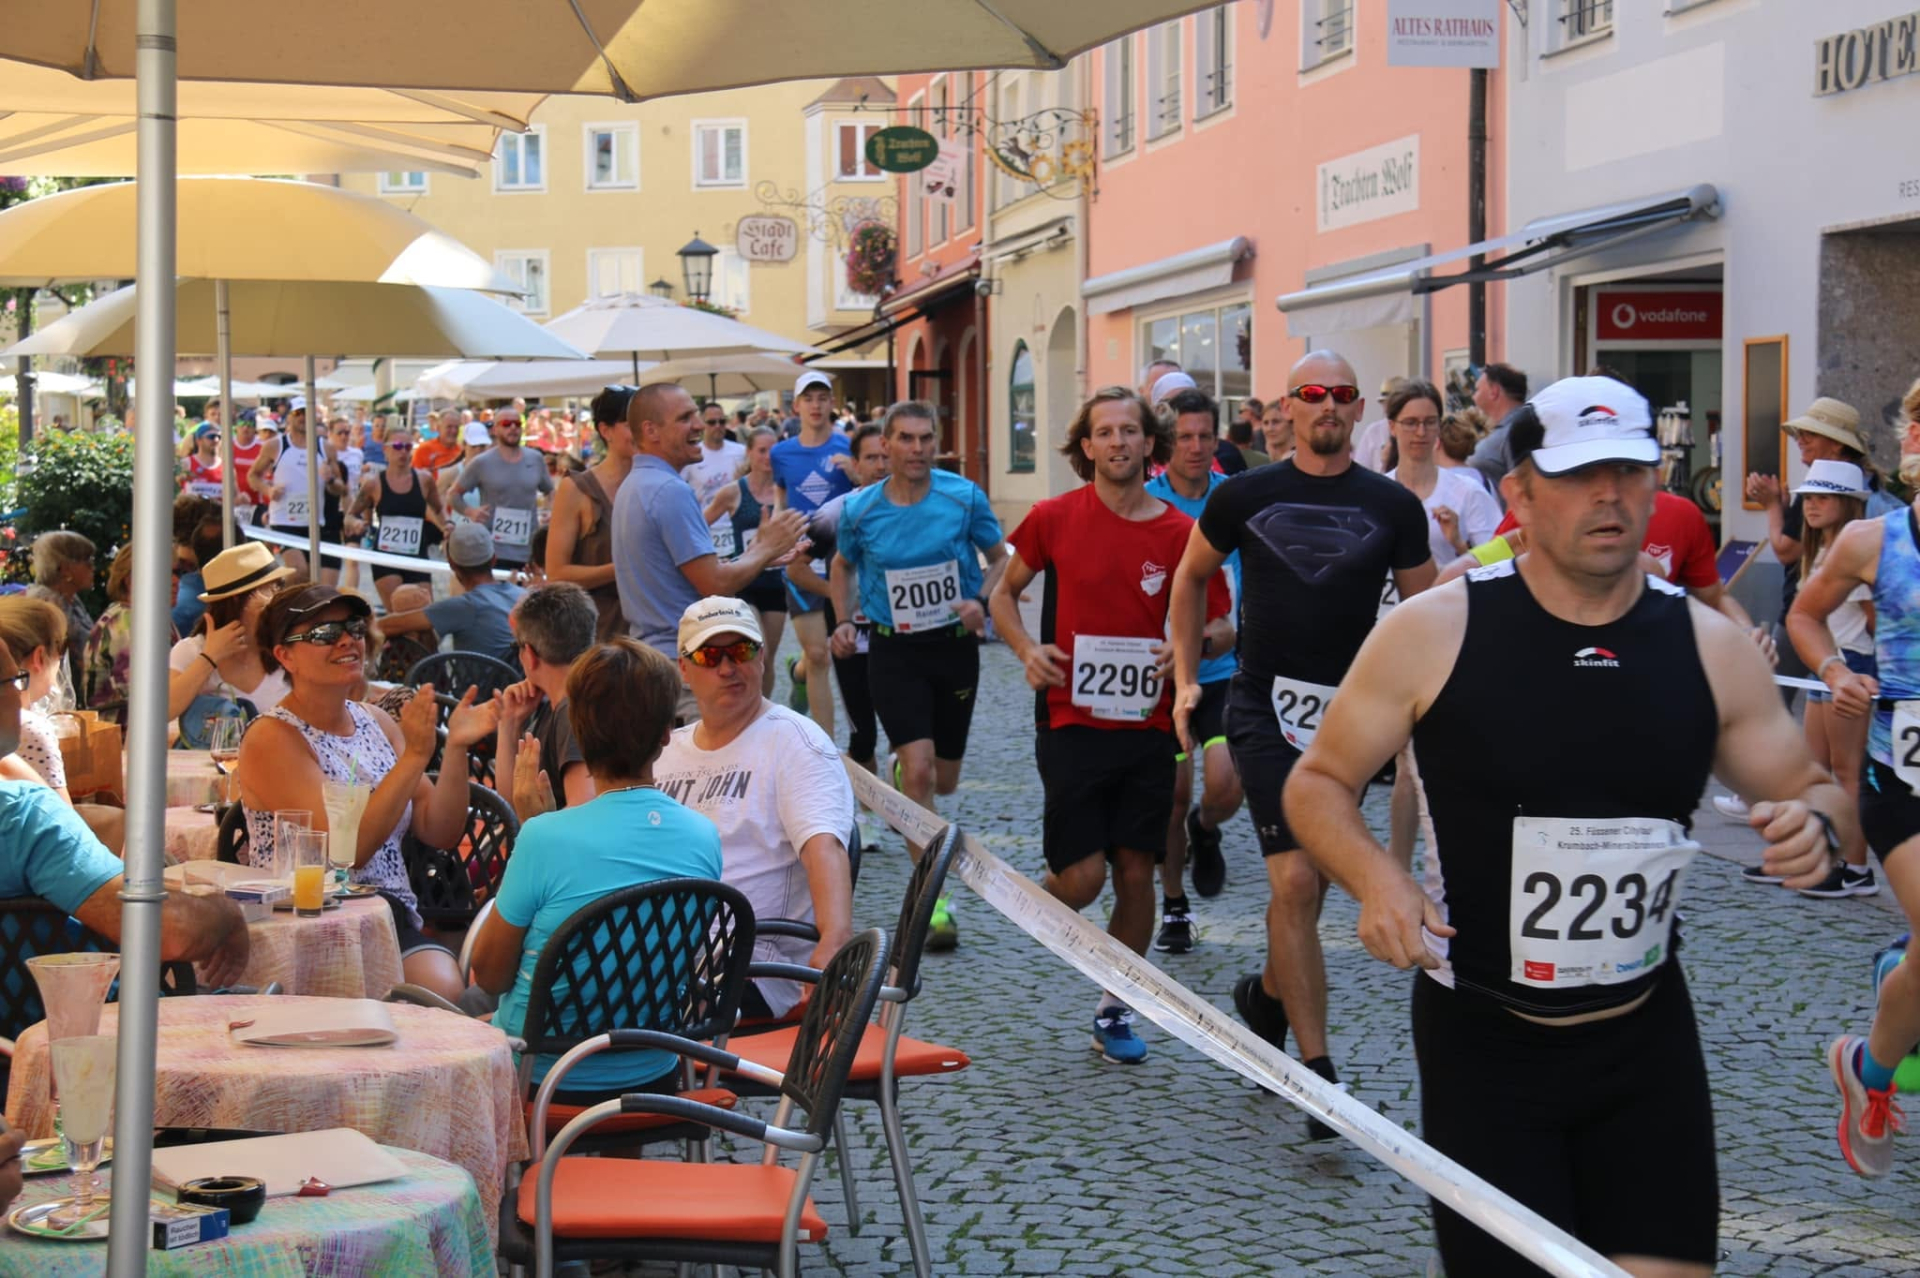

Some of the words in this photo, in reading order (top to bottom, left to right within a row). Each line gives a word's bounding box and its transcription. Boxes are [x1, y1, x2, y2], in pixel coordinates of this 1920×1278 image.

[1393, 17, 1431, 36] ALTES
[1434, 18, 1494, 37] RATHAUS
[1813, 10, 1920, 98] HOTE
[1639, 307, 1708, 322] vodafone
[1578, 415, 1619, 427] skinfit
[382, 526, 419, 544] 2210
[494, 518, 528, 535] 2211
[892, 575, 956, 610] 2008
[1574, 656, 1620, 667] skinfit
[1077, 662, 1159, 698] 2296
[1278, 689, 1331, 730] 22
[698, 770, 752, 803] JOHN
[1521, 868, 1680, 940] 2234
[170, 1223, 198, 1234] Rauchen
